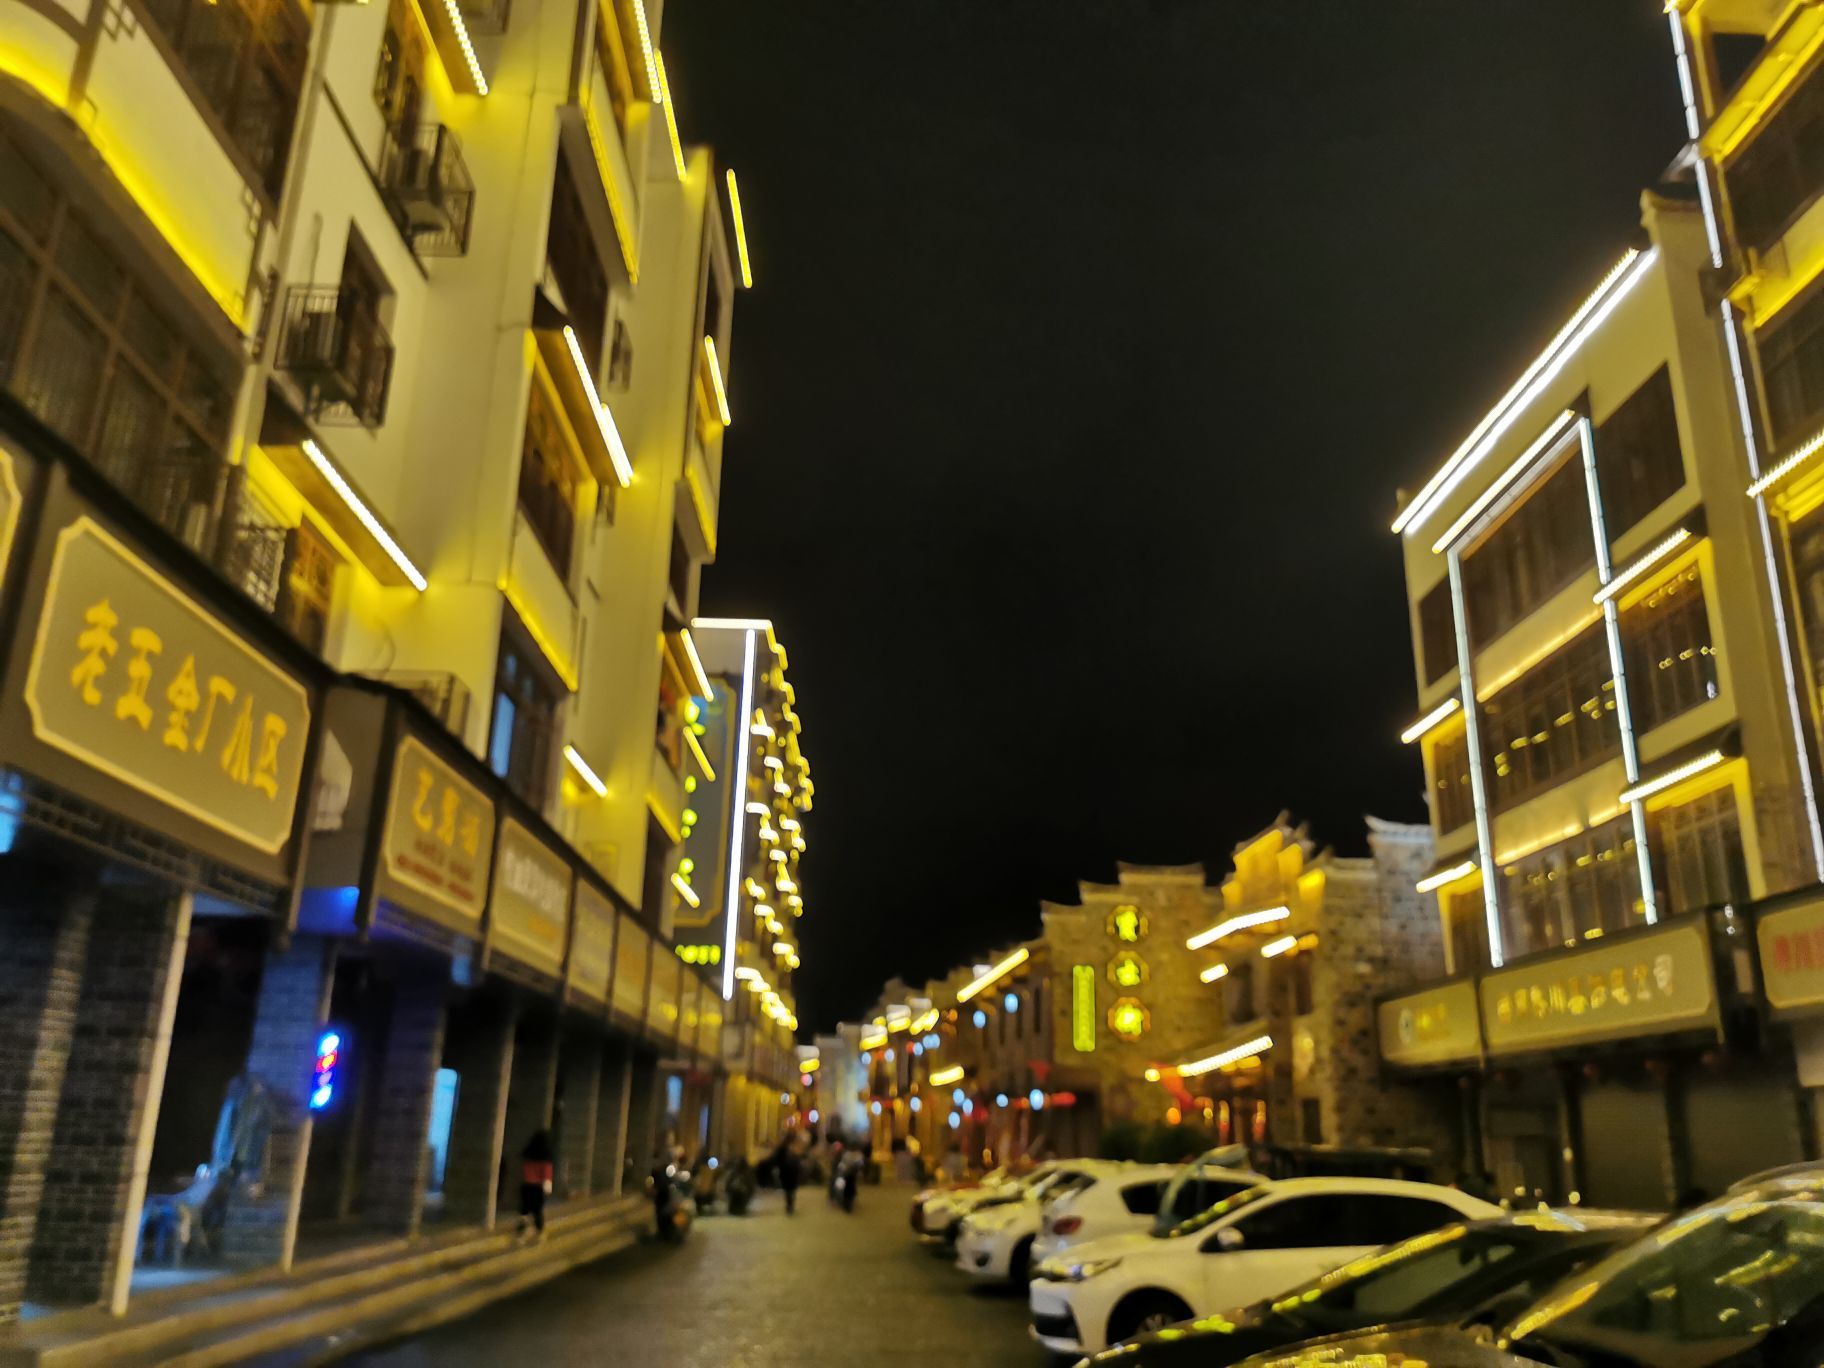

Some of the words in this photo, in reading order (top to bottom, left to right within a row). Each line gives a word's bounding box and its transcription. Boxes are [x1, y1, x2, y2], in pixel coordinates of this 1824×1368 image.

[70, 598, 288, 801] 老五金厂小区
